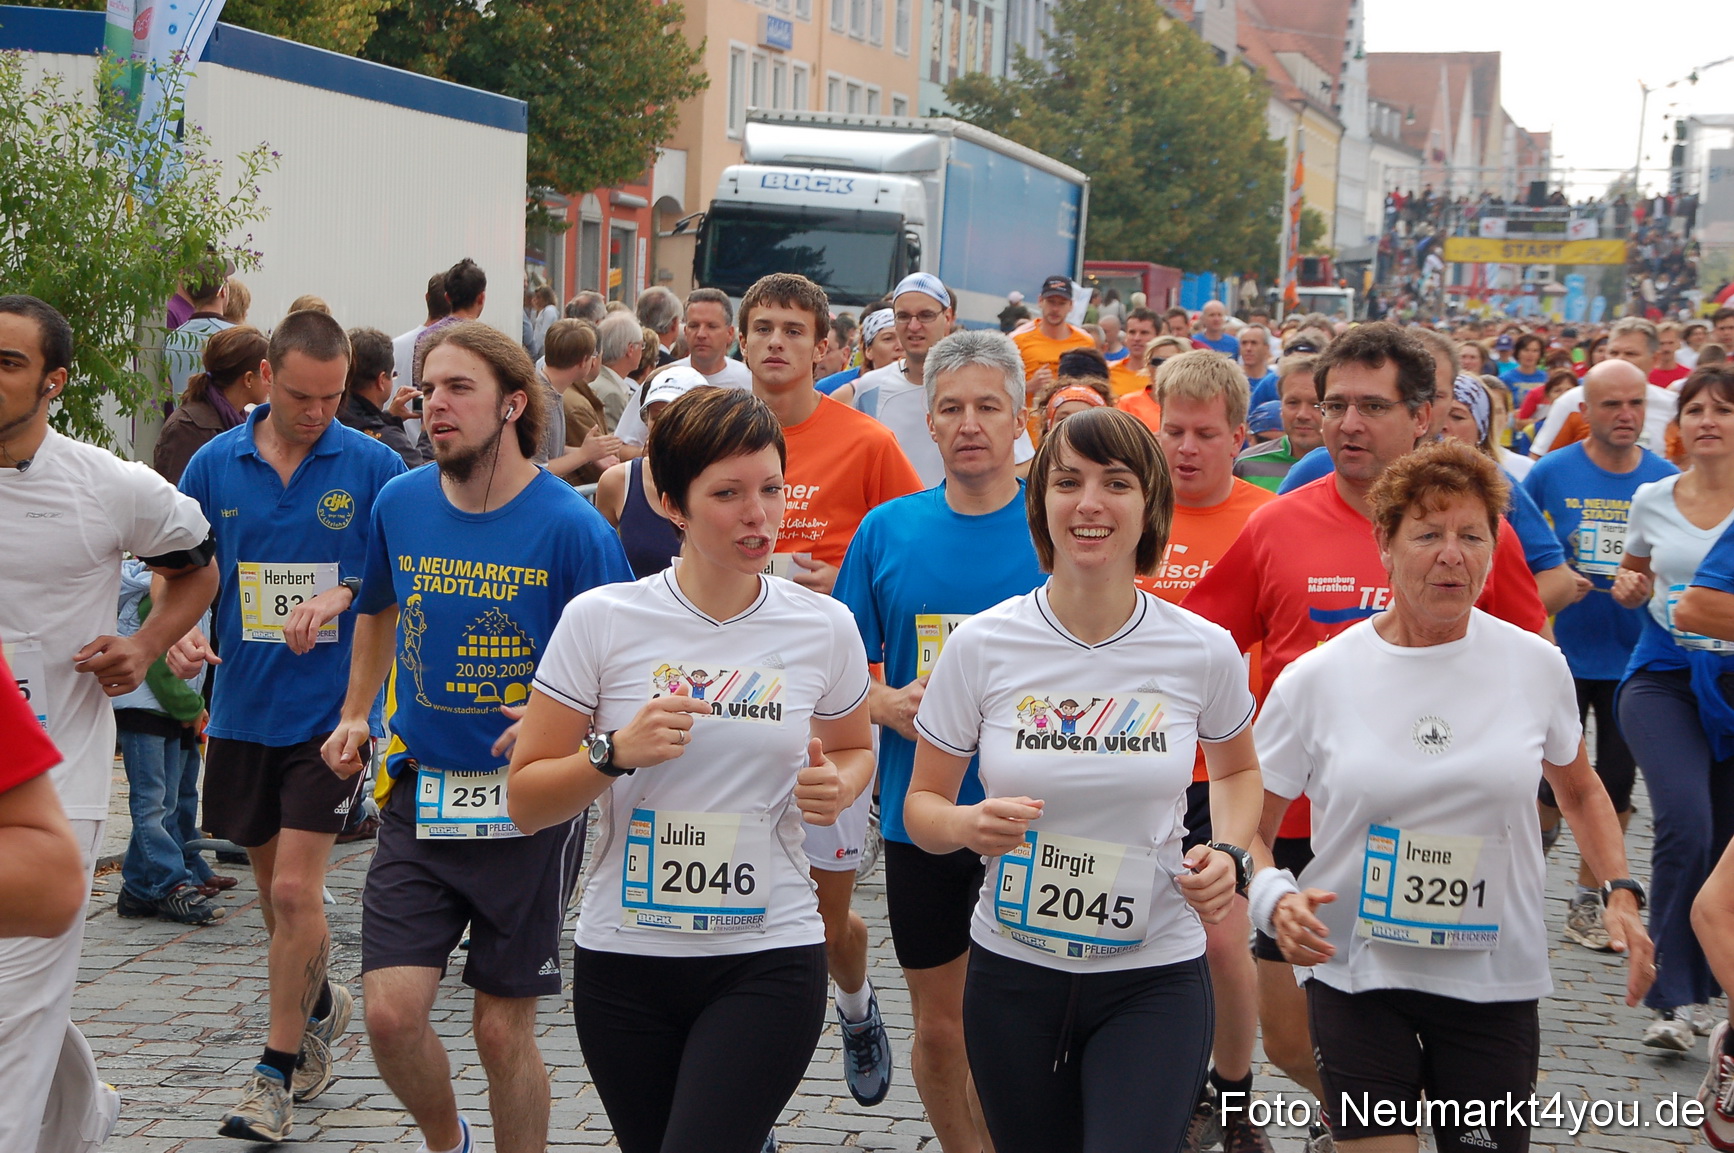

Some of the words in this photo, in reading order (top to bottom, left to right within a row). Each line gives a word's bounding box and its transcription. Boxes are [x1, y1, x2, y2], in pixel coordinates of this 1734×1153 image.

[761, 172, 855, 194] BOCK
[1502, 243, 1565, 258] START
[323, 493, 351, 512] djk
[264, 569, 315, 585] Herbert
[398, 555, 416, 572] 10.
[418, 556, 549, 587] NEUMARKTER
[1307, 575, 1356, 585] Regensburg
[412, 574, 519, 601] STADTLAUF
[1307, 583, 1355, 593] Marathon
[244, 592, 251, 603] D
[924, 649, 930, 662] D
[455, 661, 535, 678] 20.09.2009
[728, 698, 782, 721] viertl
[1015, 728, 1098, 751] farben
[1104, 730, 1168, 753] viertl
[425, 783, 432, 794] C
[451, 784, 508, 808] 251
[660, 822, 706, 846] Julia
[1041, 844, 1096, 877] Birgit
[1406, 840, 1452, 864] Irene
[628, 855, 637, 872] C
[661, 860, 756, 896] 2046
[1002, 874, 1013, 893] C
[1371, 866, 1381, 882] D
[1403, 875, 1486, 909] 3291
[1036, 883, 1135, 930] 2045
[636, 912, 672, 925] BOCK
[710, 915, 764, 926] PFLEIDERER
[1459, 1136, 1499, 1150] adidas
